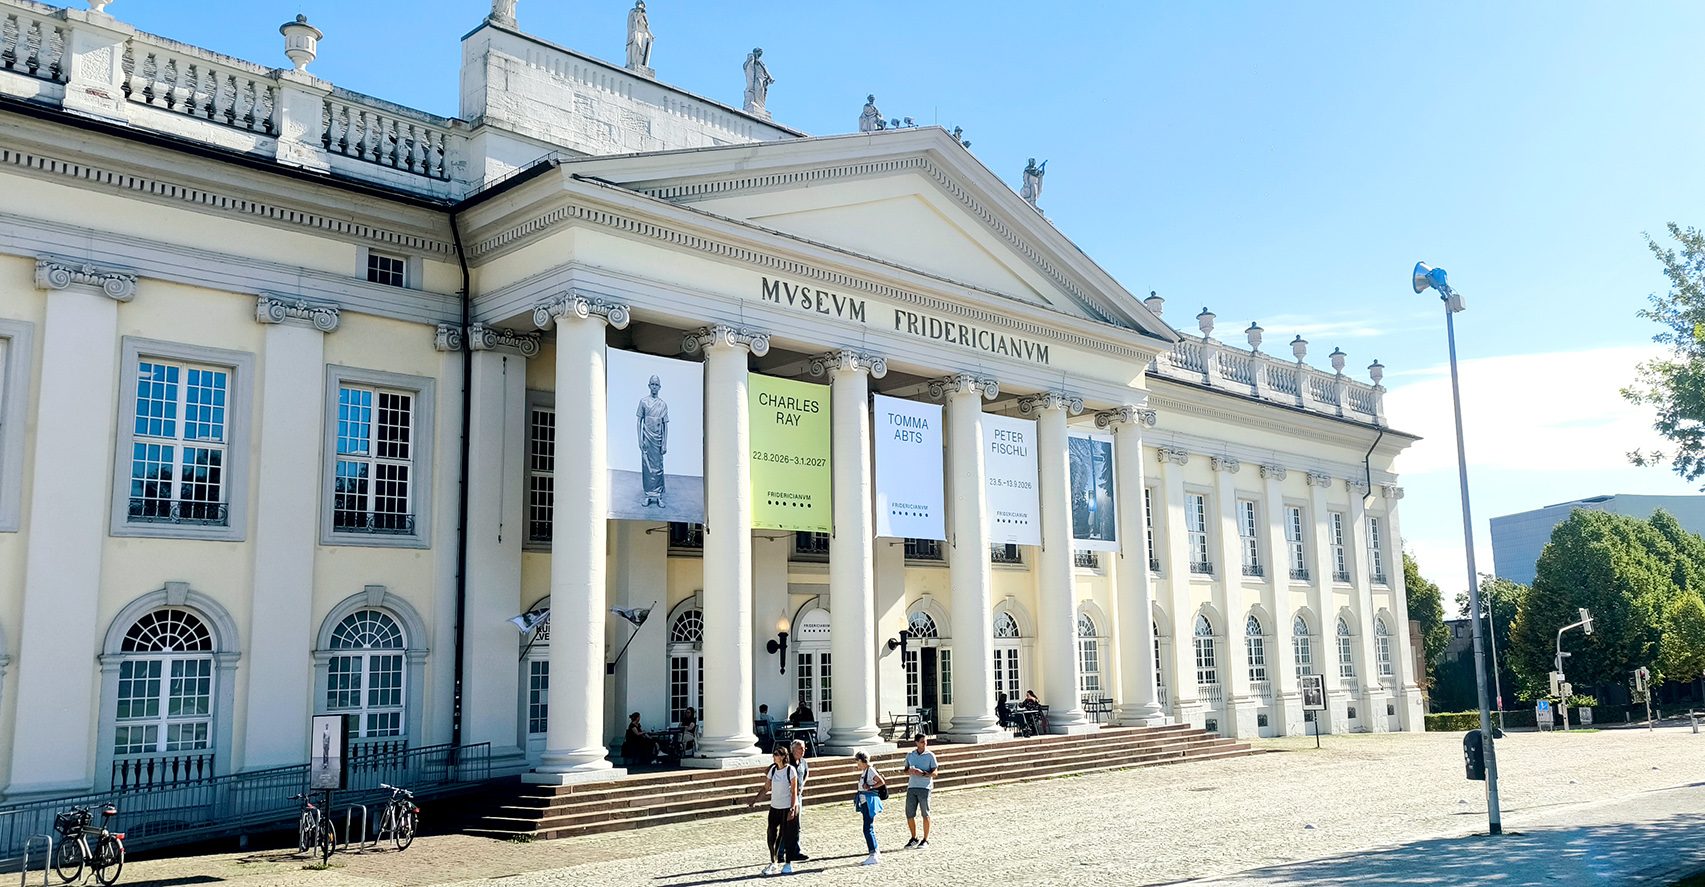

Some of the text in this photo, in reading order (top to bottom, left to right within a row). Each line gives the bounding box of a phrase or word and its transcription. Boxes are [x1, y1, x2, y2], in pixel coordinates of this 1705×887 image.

[761, 276, 1049, 365] MVSEVM FRIDERICIANVM
[759, 392, 819, 414] CHARLES
[776, 411, 801, 427] RAY
[888, 412, 929, 430] TOMMA
[893, 429, 923, 444] ABTS
[994, 429, 1023, 443] PETER
[991, 442, 1027, 457] FISCHLI
[767, 490, 811, 501] FRIDERICIANVM
